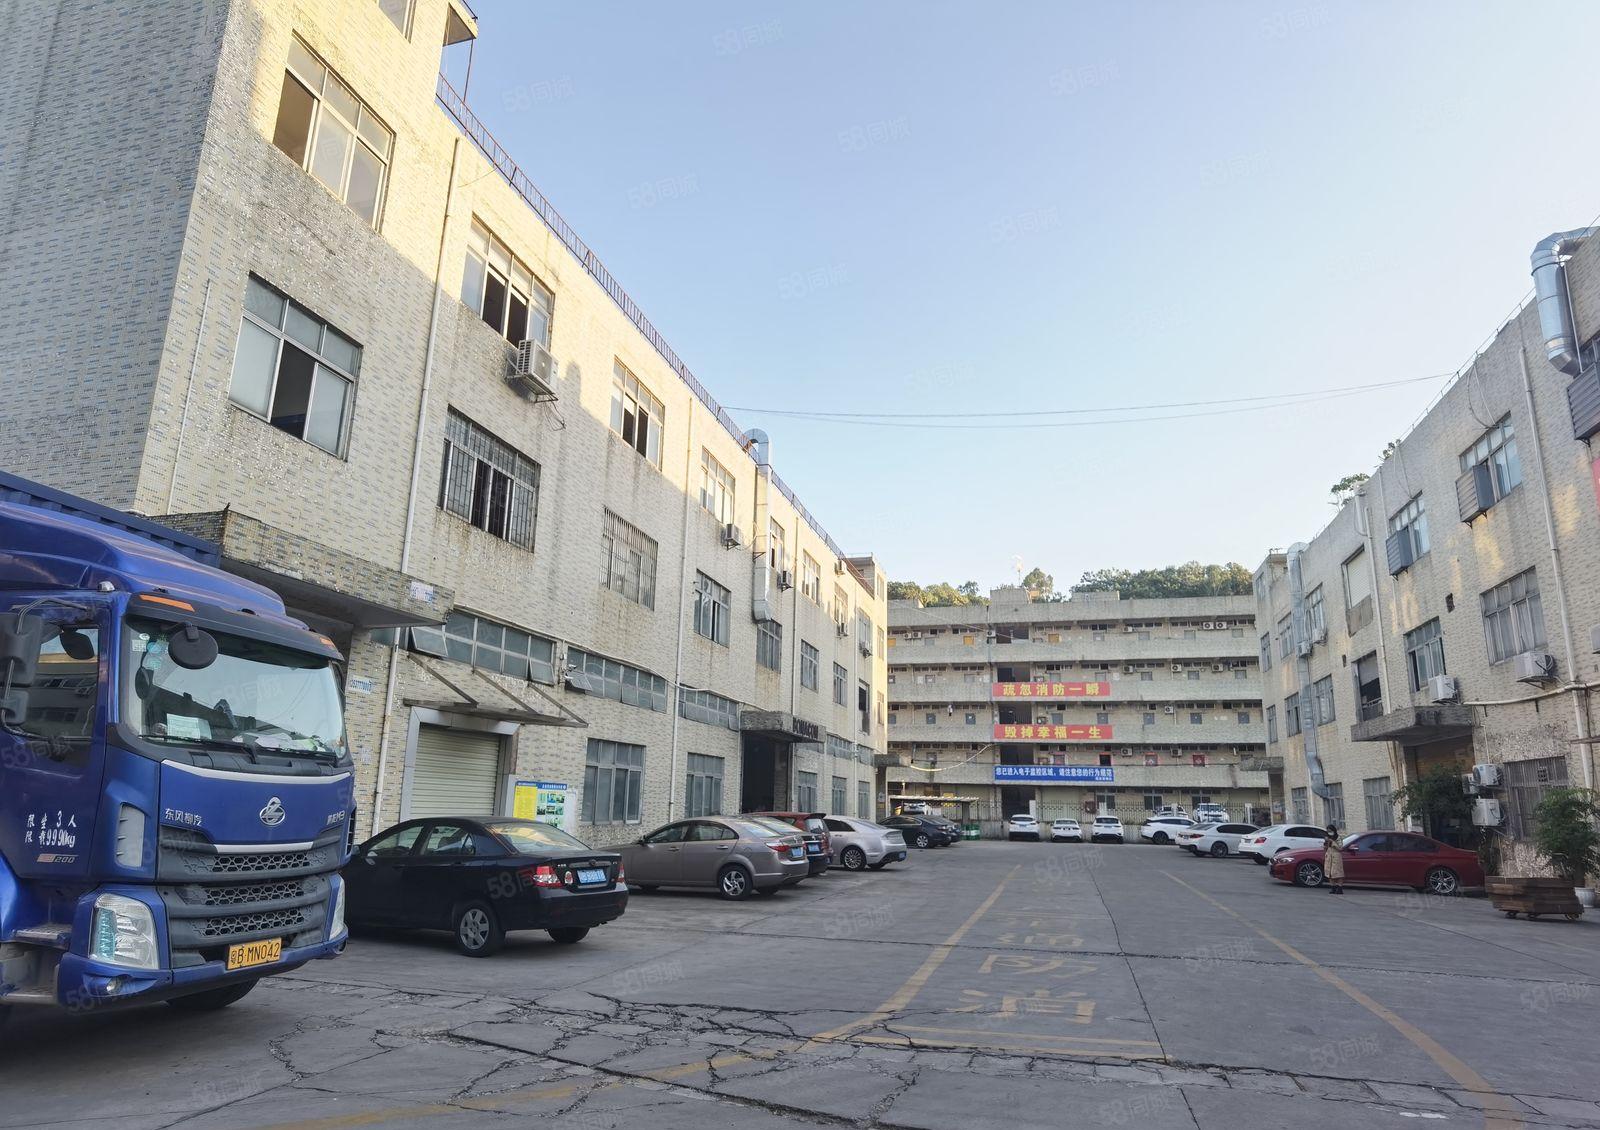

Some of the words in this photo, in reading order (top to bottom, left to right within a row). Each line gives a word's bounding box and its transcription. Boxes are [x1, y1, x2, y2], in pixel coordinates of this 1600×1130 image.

[1003, 683, 1099, 696] 疏忽消防一瞬
[1005, 726, 1101, 738] 毁掉幸福一生
[165, 808, 202, 827] 东风柳汽
